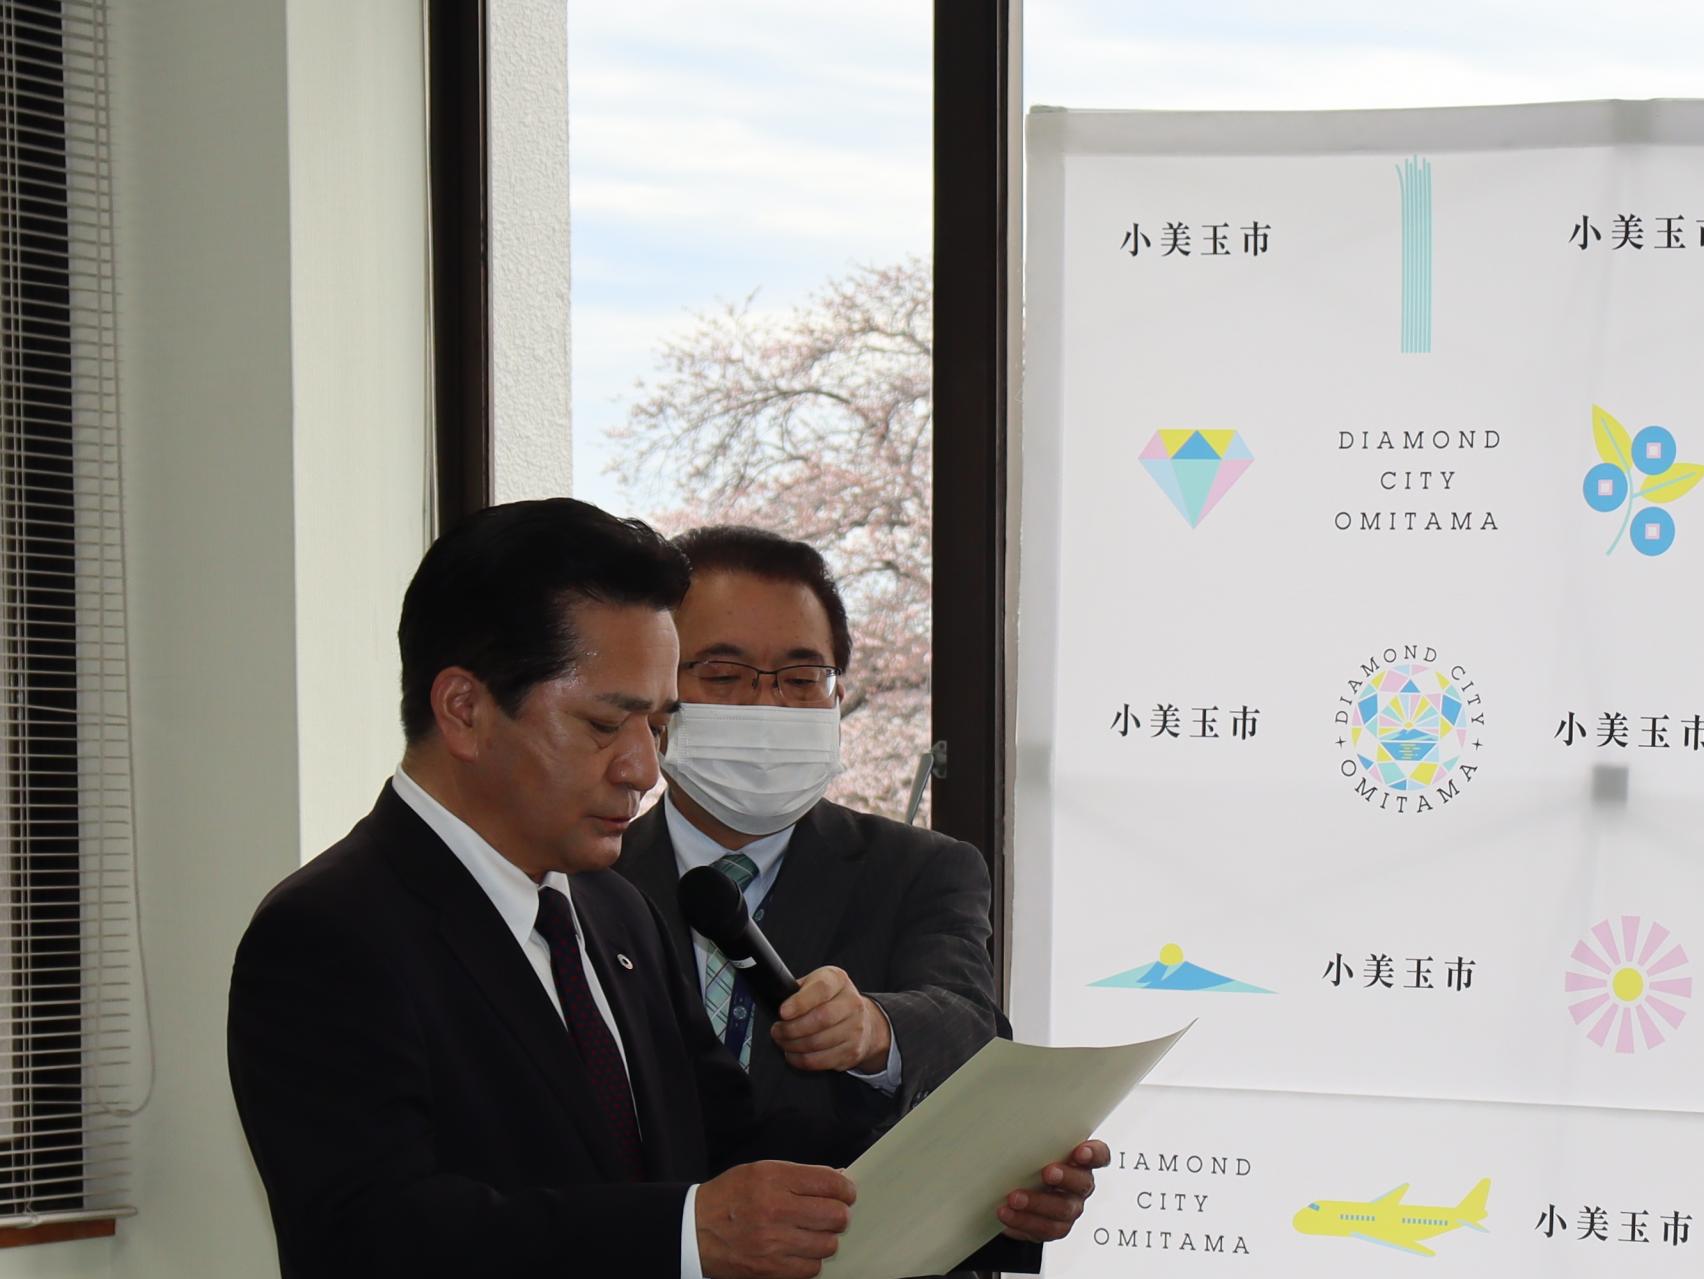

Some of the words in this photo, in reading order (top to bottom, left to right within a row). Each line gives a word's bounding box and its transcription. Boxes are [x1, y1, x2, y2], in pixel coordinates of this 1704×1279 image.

[1119, 220, 1272, 258] 小美玉市
[1338, 430, 1500, 450] DIAMOND
[1380, 471, 1456, 490] CITY
[1334, 511, 1499, 531] OMITAMA
[1335, 645, 1438, 725] DIAMOND
[1451, 665, 1485, 726] CITY
[1110, 703, 1261, 741] 小美玉市
[1341, 759, 1478, 814] OMITAMA
[1322, 952, 1477, 992] 小美玉市
[1117, 1151, 1252, 1177] IAMOND
[1136, 1191, 1209, 1213] CITY
[1093, 1227, 1250, 1255] OMITAMA
[1534, 1203, 1693, 1247] 小美玉市
